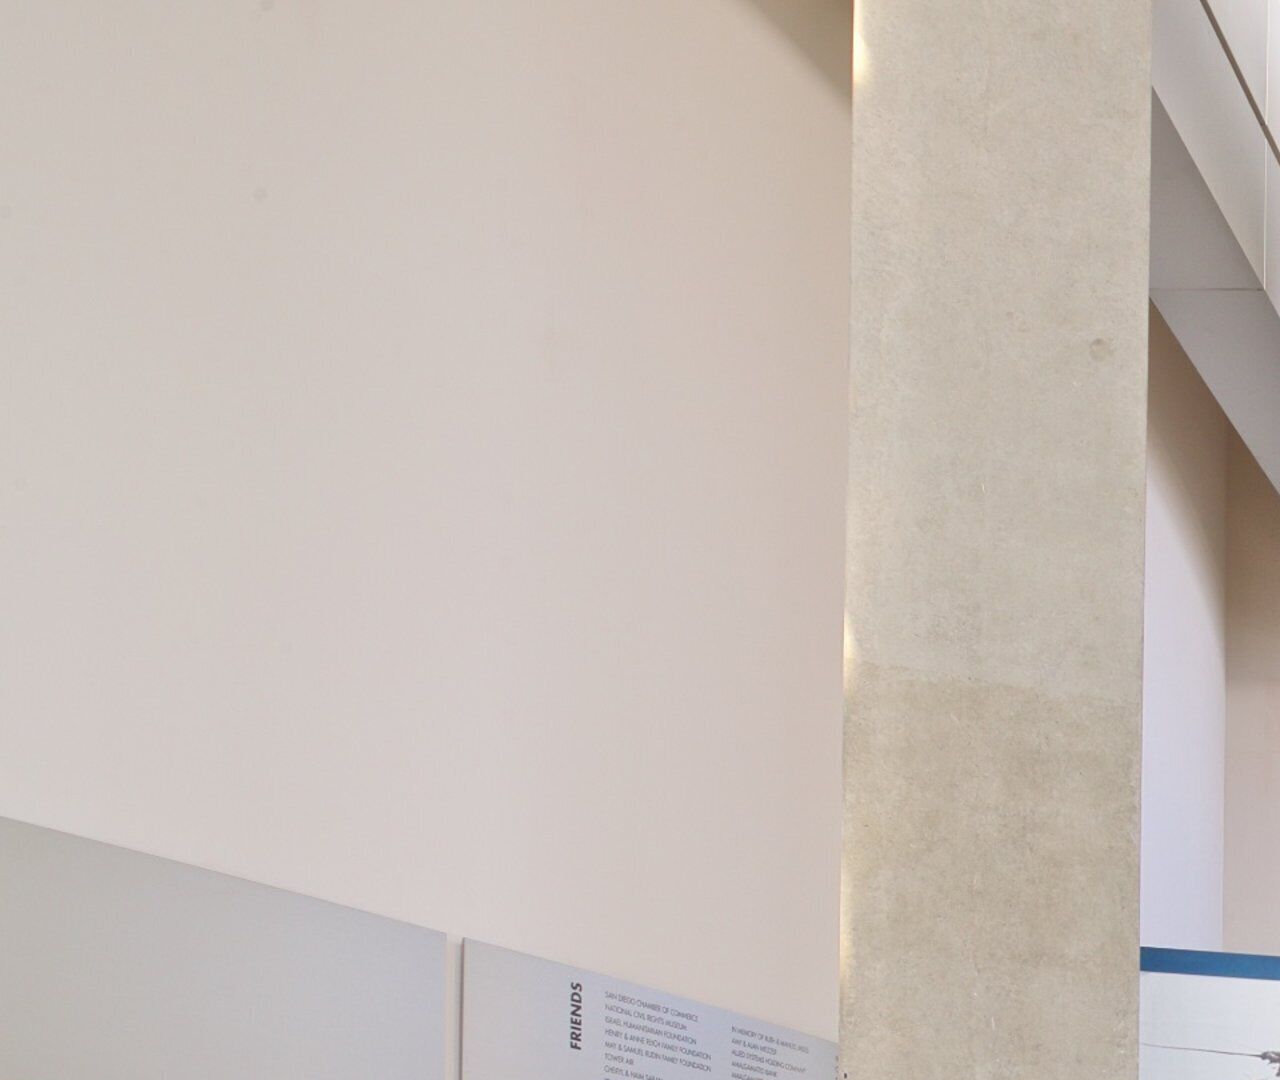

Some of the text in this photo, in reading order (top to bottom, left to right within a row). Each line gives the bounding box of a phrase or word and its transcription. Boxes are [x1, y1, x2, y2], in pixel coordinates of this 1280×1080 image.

[570, 982, 583, 1050] FRIENDS
[605, 1003, 632, 1016] NATIONAL
[665, 1019, 686, 1030] MUSEUM
[618, 994, 635, 1006] DIEGO
[636, 999, 660, 1012] CHAMBER
[670, 1008, 697, 1022] COMMERCE
[605, 1015, 696, 1044] ISRAEL HUMANITARIAN FOUNDATION
[604, 1052, 623, 1063] TOWER
[605, 1028, 621, 1039] HENRY
[629, 1034, 645, 1044] ANNE
[661, 1042, 677, 1052] FAMILY
[679, 1046, 711, 1060] FOUNDATION
[604, 1064, 624, 1076] CHERYL
[623, 1045, 643, 1056] SAMUEL
[662, 1054, 678, 1064] FAMILY
[679, 1058, 711, 1072] FOUNDATION
